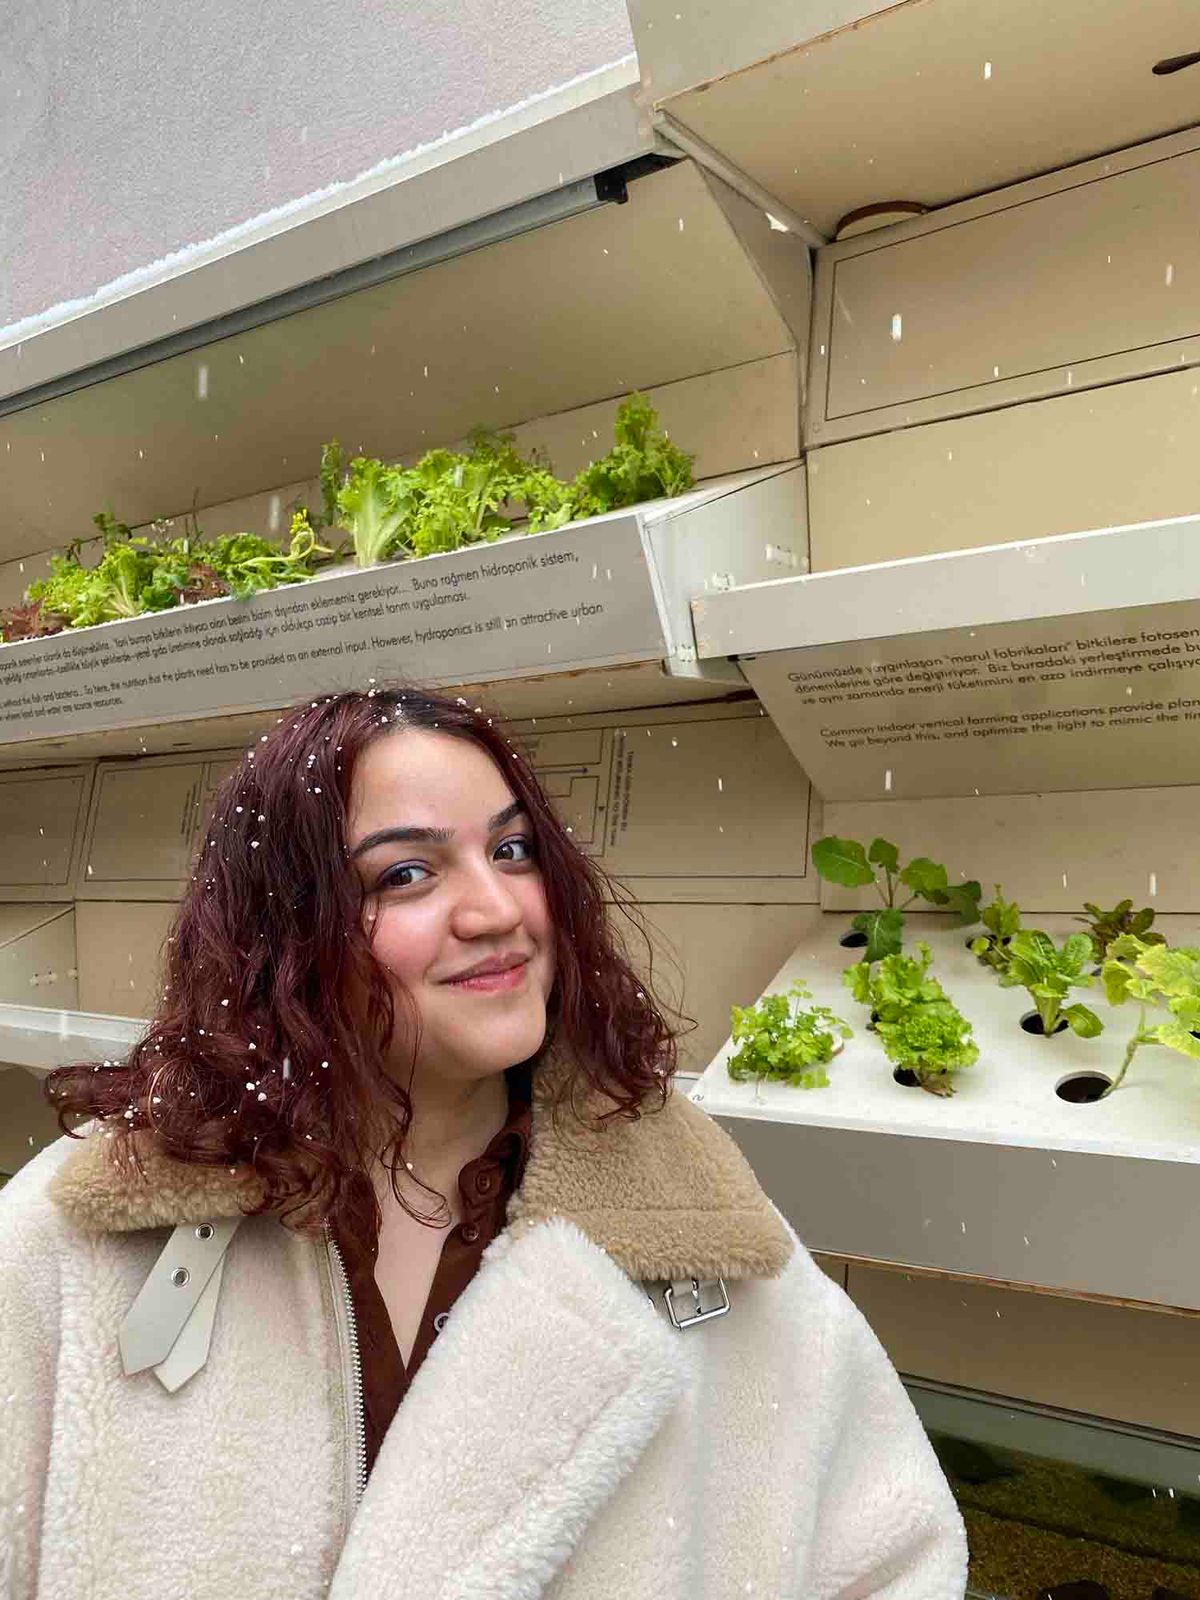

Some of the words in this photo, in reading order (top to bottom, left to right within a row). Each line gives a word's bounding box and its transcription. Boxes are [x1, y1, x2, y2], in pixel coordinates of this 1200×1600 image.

[209, 617, 227, 630] olan
[412, 577, 438, 591] Buna
[441, 570, 479, 587] rağmen
[480, 558, 538, 578] hidroponik
[540, 552, 579, 568] sistem,
[281, 618, 314, 633] oldukça
[315, 613, 338, 627] cazip
[339, 609, 352, 623] bir
[353, 604, 385, 619] kentsel
[386, 600, 411, 614] tarım
[162, 671, 173, 681] the
[174, 668, 196, 681] plants
[196, 664, 215, 676] need
[216, 661, 229, 673] has
[230, 661, 239, 671] to
[239, 658, 250, 670] be
[251, 653, 285, 669] provided
[287, 653, 297, 662] as
[298, 650, 309, 660] an
[310, 642, 343, 659] external
[345, 639, 371, 654] input.
[371, 634, 413, 649] However,
[415, 623, 473, 644] hydroponics
[475, 621, 483, 633] is
[486, 615, 501, 631] still
[505, 617, 517, 628] an
[520, 609, 569, 626] attractive
[571, 602, 604, 618] urban
[788, 664, 863, 682] Günümüzde
[865, 658, 942, 674] yaygınlaşan
[1076, 636, 1137, 650] bitkilere
[1141, 628, 1200, 643] fotosen
[795, 678, 871, 693] dönemlerine
[873, 675, 903, 687] göre
[987, 663, 1010, 673] Biz
[1011, 655, 1076, 671] buradaki
[1080, 644, 1181, 665] yerleştirmede
[818, 694, 843, 704] aynı
[846, 687, 904, 700] zamanda
[908, 682, 944, 693] enerji
[947, 677, 1013, 690] tüketimini
[1018, 675, 1036, 683] en
[1040, 672, 1066, 681] aza
[1070, 664, 1143, 677] indirmeye
[820, 726, 875, 737] Common
[877, 721, 916, 732] indoor
[919, 716, 964, 729] vertical
[967, 714, 1018, 725] farming
[1021, 707, 1106, 721] applications
[1109, 700, 1164, 715] provide
[825, 738, 846, 748] We
[849, 740, 865, 748] go
[866, 733, 911, 745] beyond
[915, 731, 940, 741] this,
[944, 728, 969, 738] and
[972, 725, 1027, 738] optimize
[1031, 721, 1053, 732] the
[1057, 720, 1086, 732] light
[1092, 719, 1105, 727] to
[1108, 716, 1153, 726] mimic
[1156, 711, 1180, 722] the
